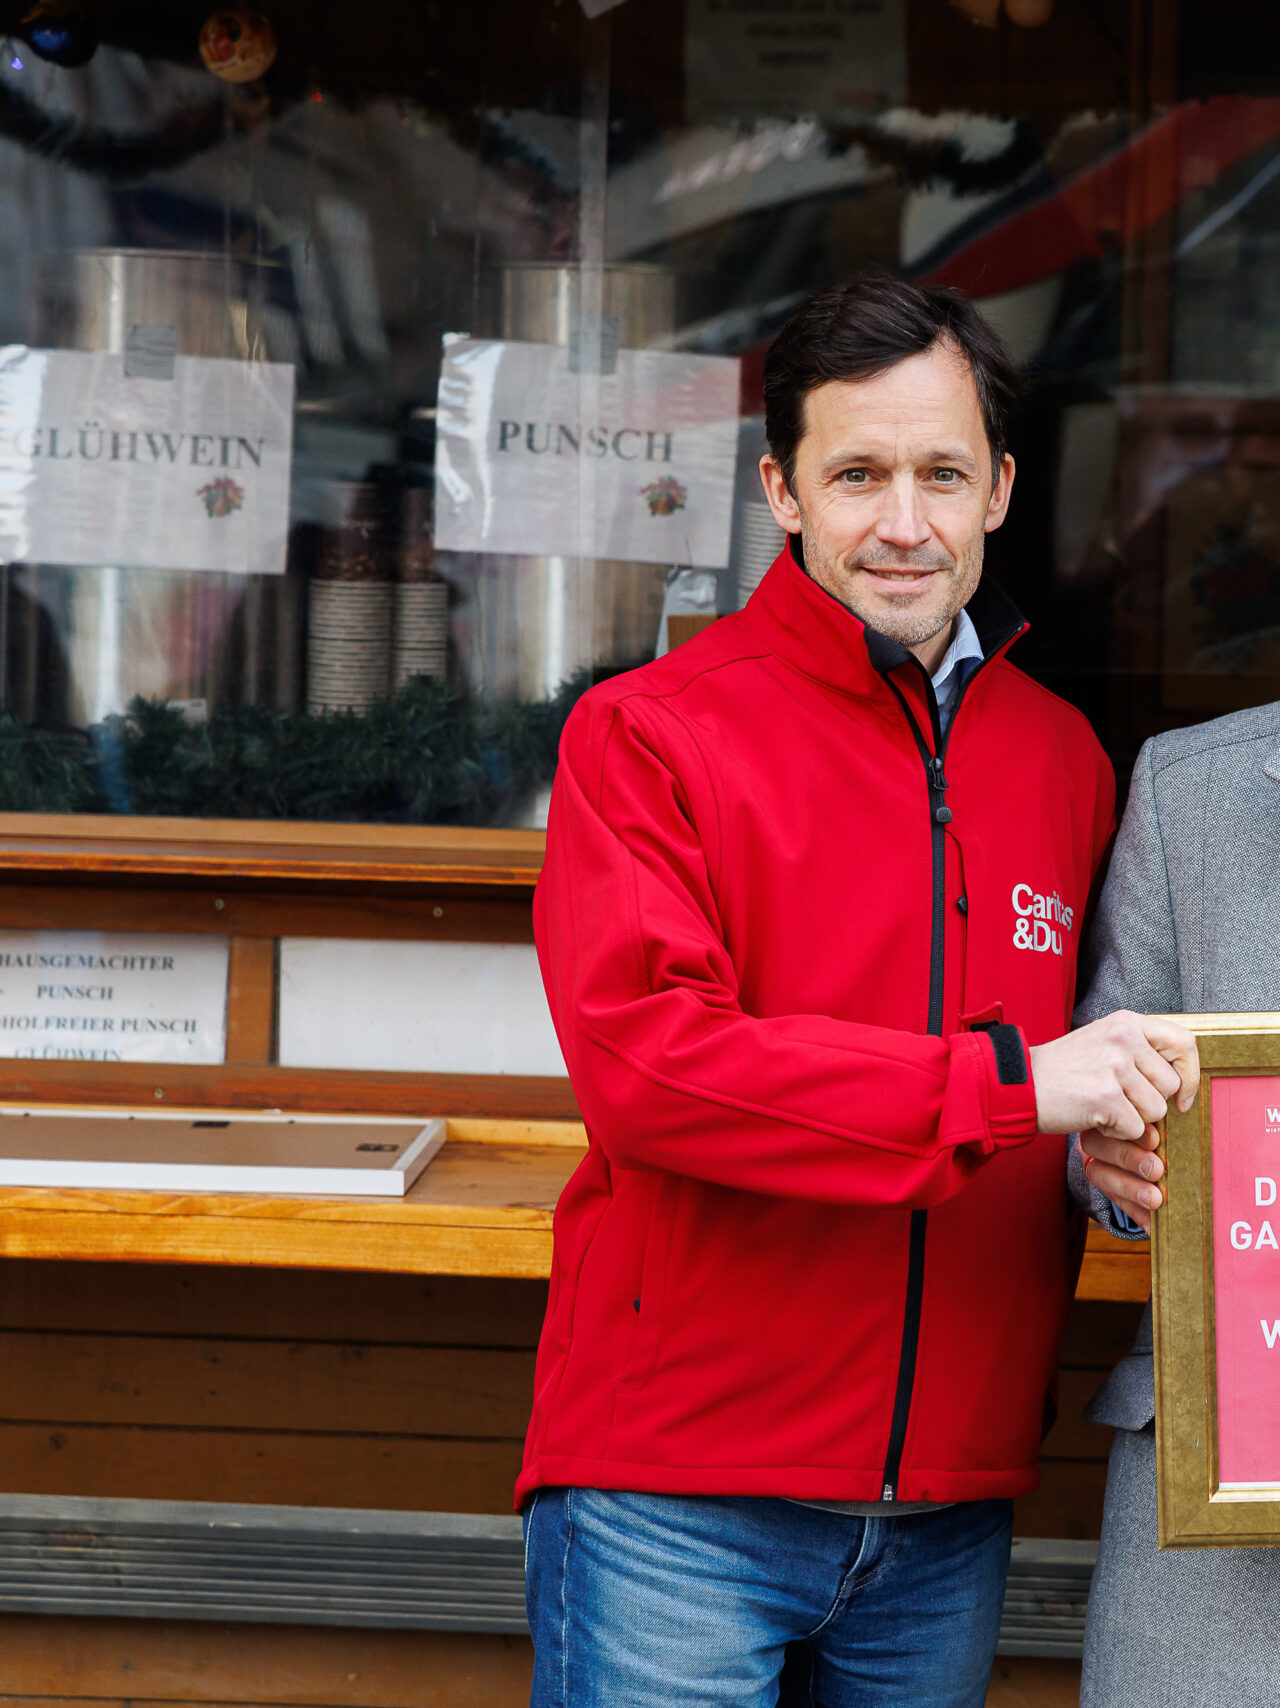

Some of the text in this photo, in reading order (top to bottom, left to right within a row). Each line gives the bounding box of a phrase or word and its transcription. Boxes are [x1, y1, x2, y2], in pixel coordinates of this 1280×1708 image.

[15, 421, 265, 469] GLÜHWEIN
[498, 420, 674, 462] PUNSCH
[1011, 883, 1074, 932] Caritas
[1012, 917, 1062, 955] &Du
[36, 984, 114, 1000] PUNSCH
[121, 1018, 197, 1033] PUNSCH
